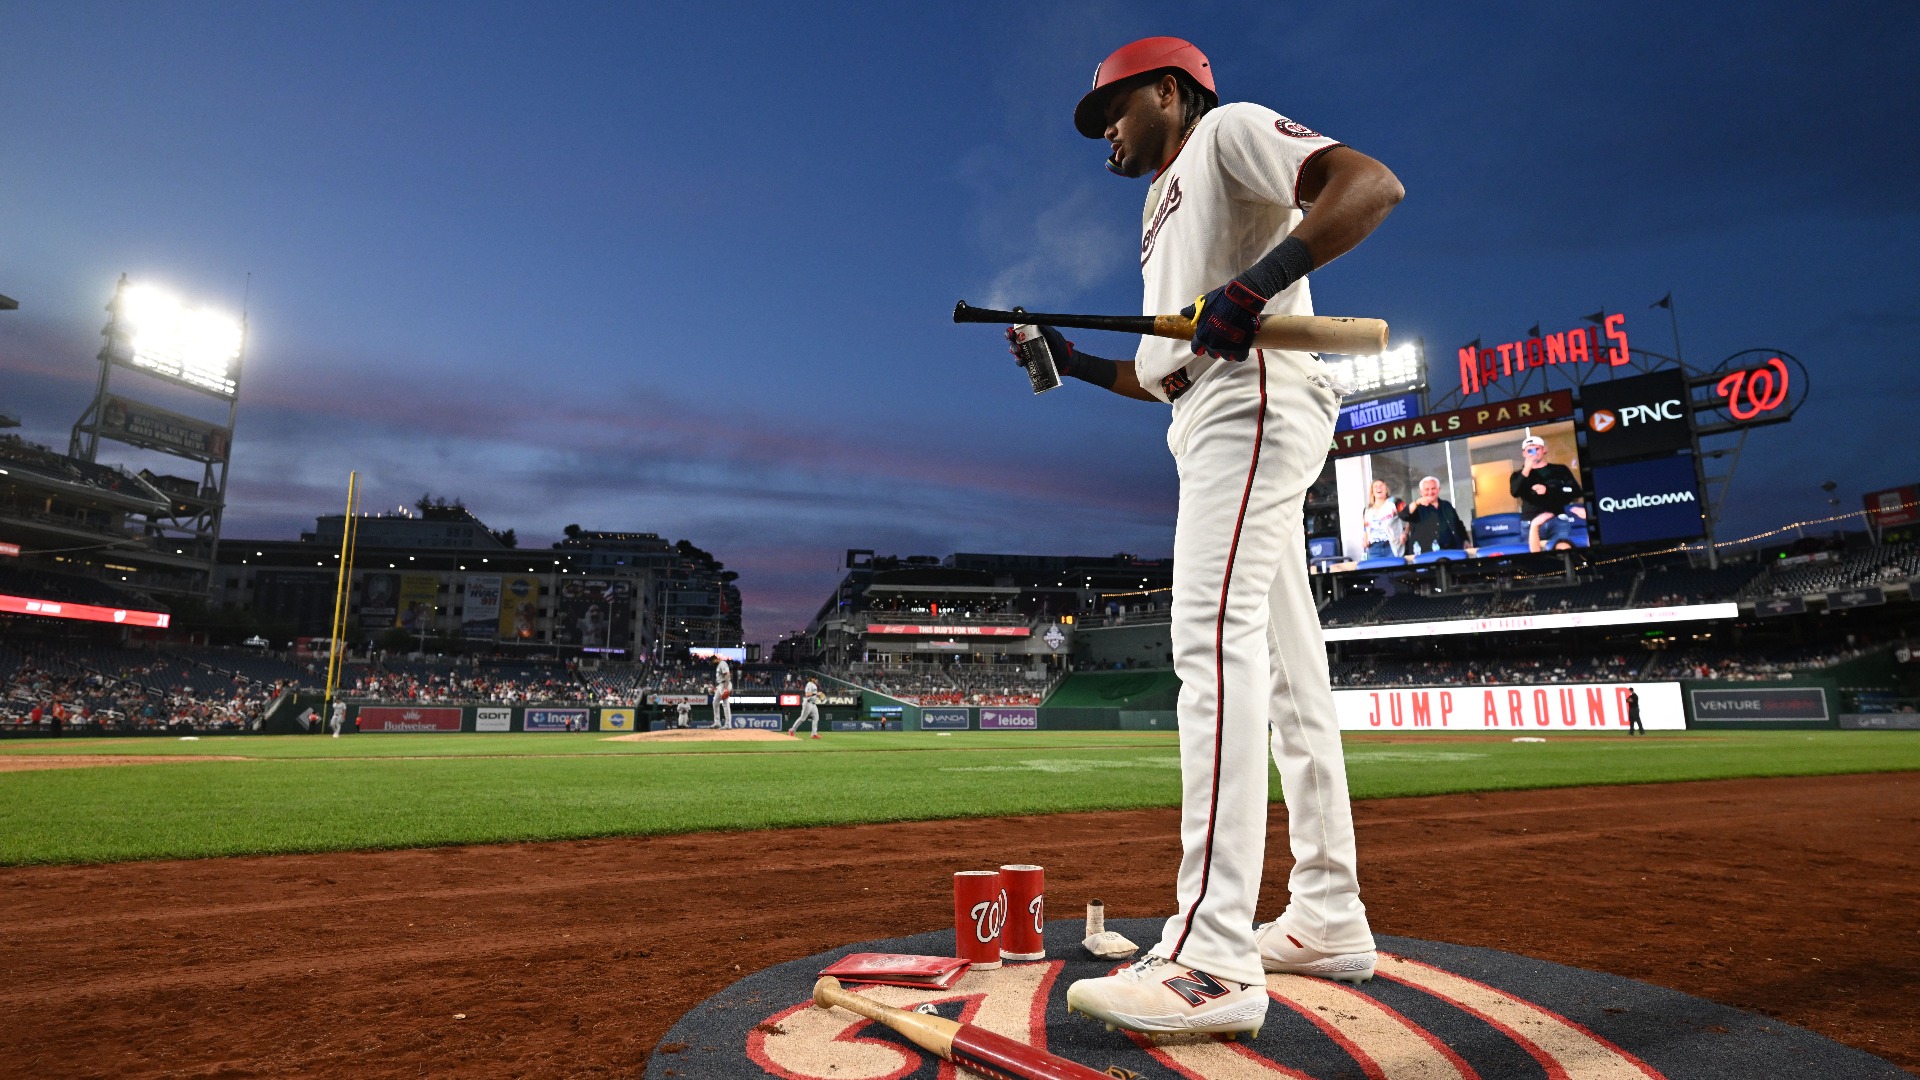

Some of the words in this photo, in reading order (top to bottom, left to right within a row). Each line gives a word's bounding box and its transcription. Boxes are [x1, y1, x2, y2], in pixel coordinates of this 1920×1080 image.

[1458, 313, 1631, 395] NATIONALS
[1716, 357, 1789, 420] W
[1360, 399, 1380, 410] SOME
[1349, 399, 1407, 427] NATITUDE
[1617, 399, 1683, 428] PNC
[1329, 415, 1462, 452] ATIONALS
[1476, 398, 1554, 425] PARK
[1598, 489, 1695, 513] Qualcomm
[470, 590, 499, 599] HVAC
[918, 625, 932, 634] THIS
[933, 625, 953, 635] BUD'S
[953, 626, 967, 635] FOR
[967, 626, 982, 636] YOU.
[685, 696, 706, 704] eeter
[829, 696, 854, 705] FAN
[1700, 700, 1761, 711] VENTURE
[1369, 691, 1453, 727] JUMP
[1483, 687, 1633, 727] AROUND
[478, 712, 510, 720] GDIT
[547, 712, 579, 723] Inov
[746, 716, 778, 728] Terra
[998, 714, 1035, 726] leidos
[384, 720, 438, 732] Budweiser
[1162, 969, 1231, 1008] N
